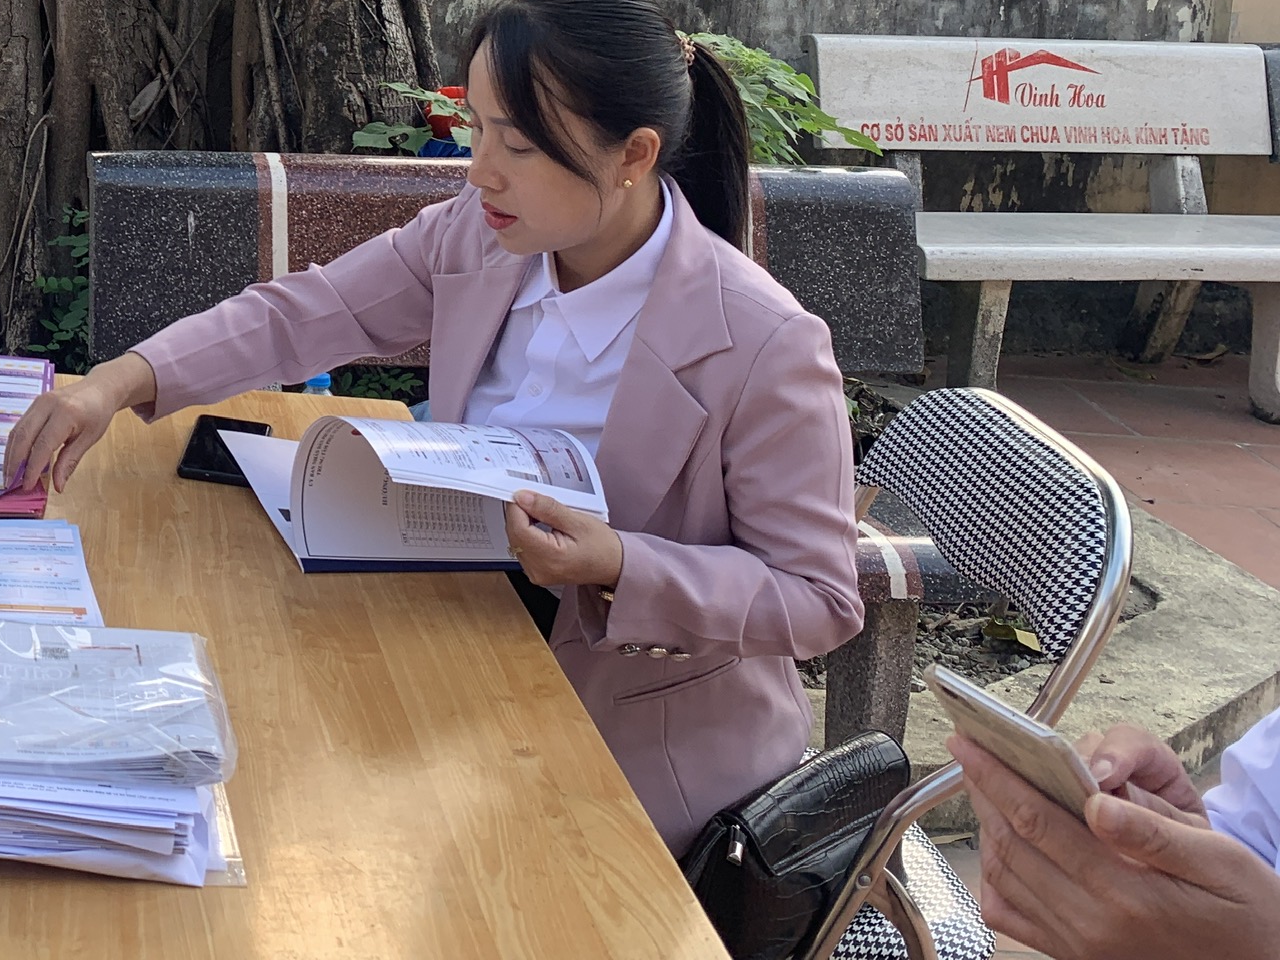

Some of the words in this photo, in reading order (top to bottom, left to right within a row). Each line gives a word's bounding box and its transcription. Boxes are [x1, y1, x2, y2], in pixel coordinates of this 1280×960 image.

[1014, 82, 1061, 109] Vinh
[1066, 83, 1107, 109] Hoa
[860, 122, 881, 142] CƠ
[885, 116, 905, 142] SỞ
[908, 117, 938, 143] SẢN
[942, 116, 982, 143] XUẤT
[985, 123, 1017, 143] NEM
[1020, 124, 1060, 144] CHUA
[1063, 125, 1098, 144] VINH
[1101, 126, 1132, 145] HOA
[1135, 122, 1168, 145] KÍNH
[1171, 121, 1210, 150] TẶNG
